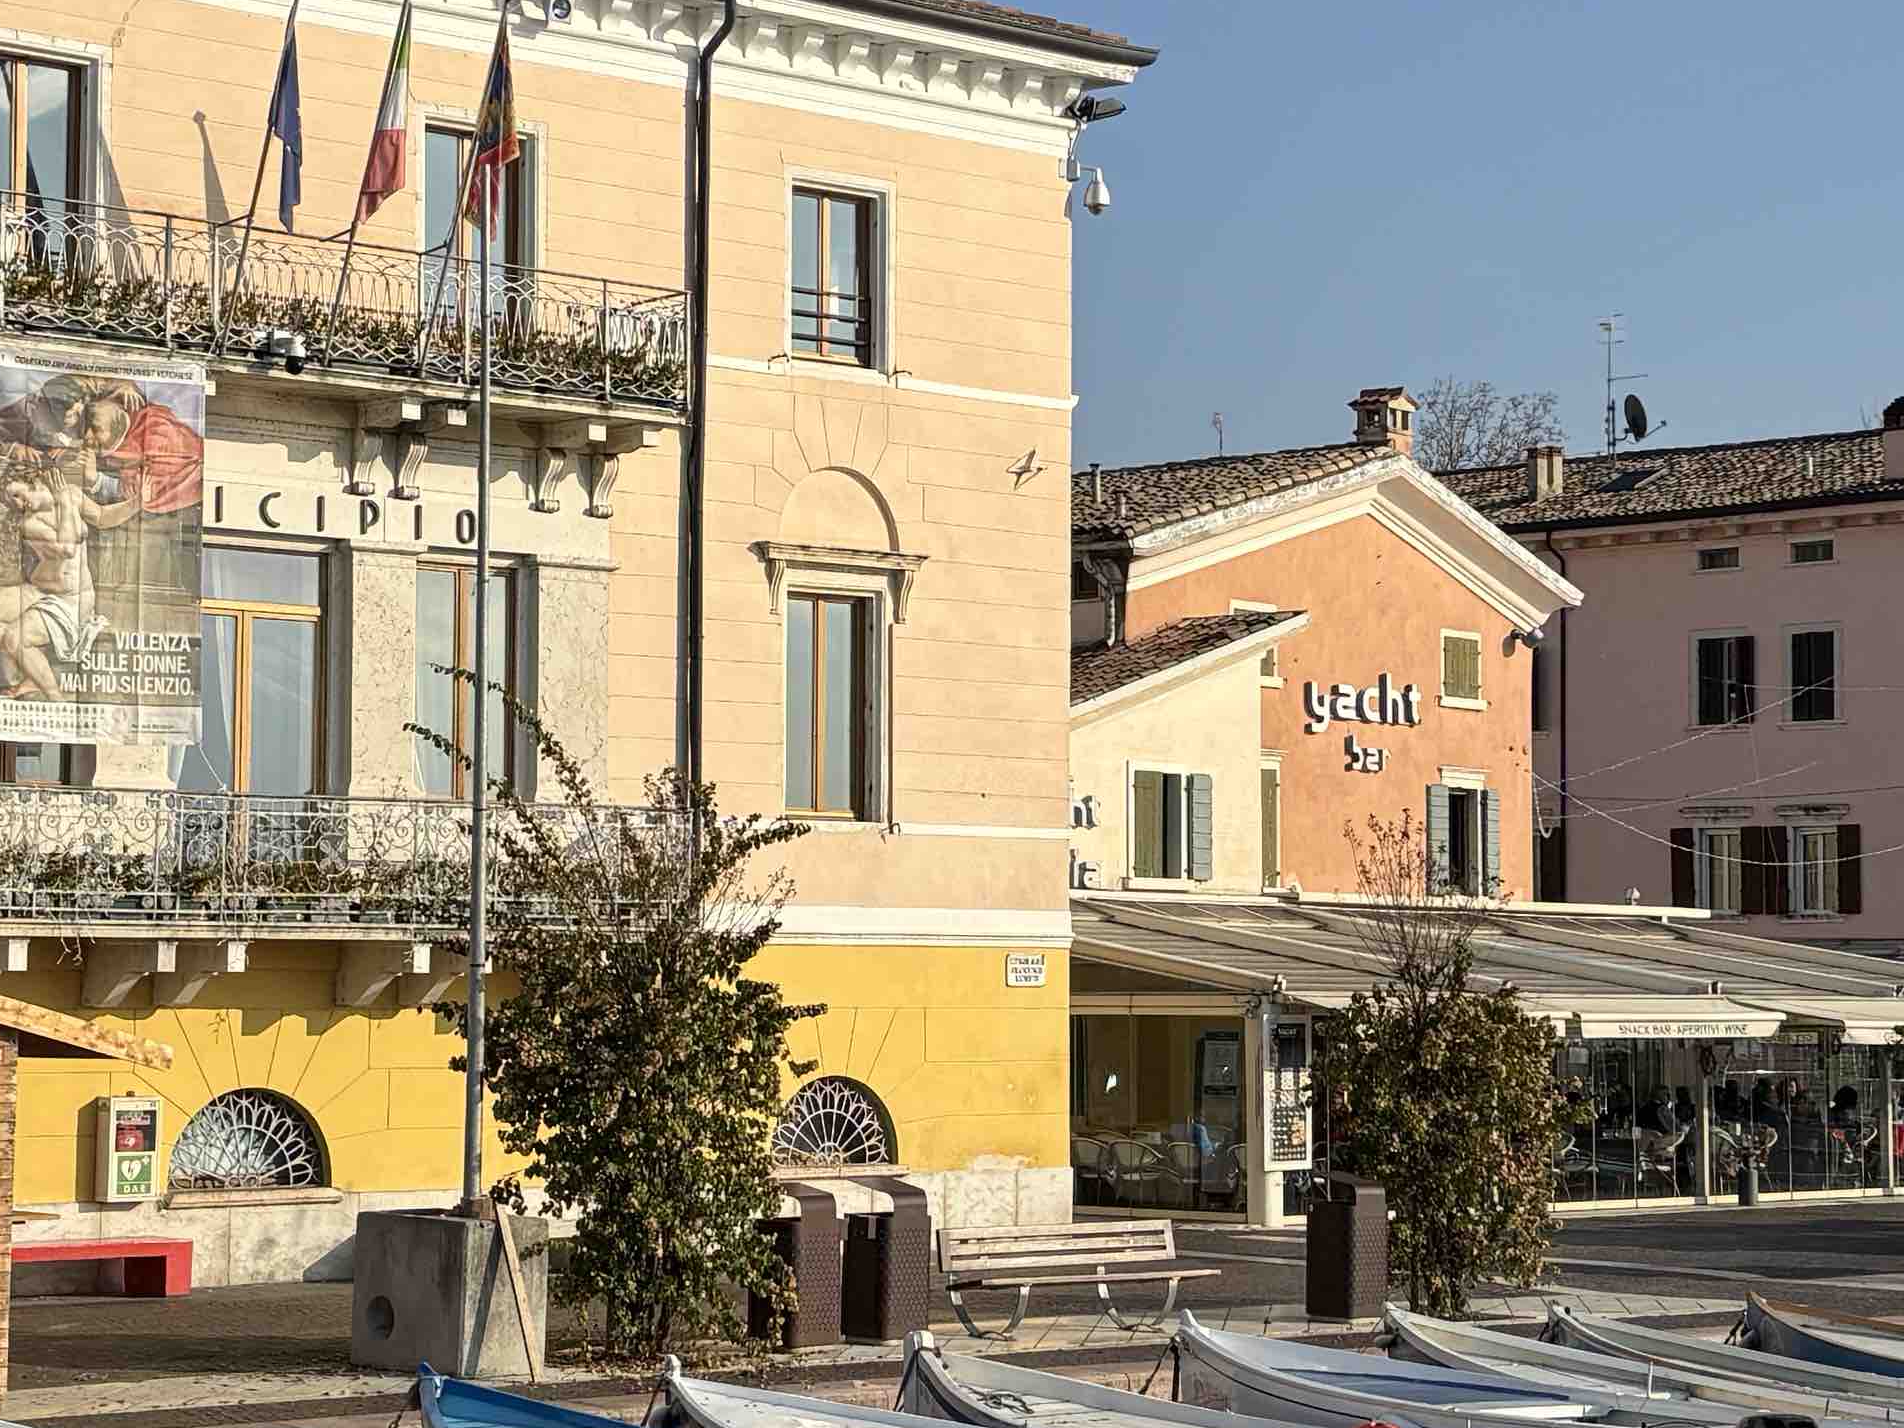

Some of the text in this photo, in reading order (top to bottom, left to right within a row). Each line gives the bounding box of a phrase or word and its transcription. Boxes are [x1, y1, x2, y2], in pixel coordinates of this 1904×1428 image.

[215, 485, 476, 544] ICIPIO
[115, 632, 192, 652] VIOLENZA
[82, 652, 191, 674] SULLE DONNE.
[60, 671, 195, 697] MAI PIÙ SILENZIO.
[1303, 671, 1422, 735] yacht
[1344, 733, 1392, 773] bar
